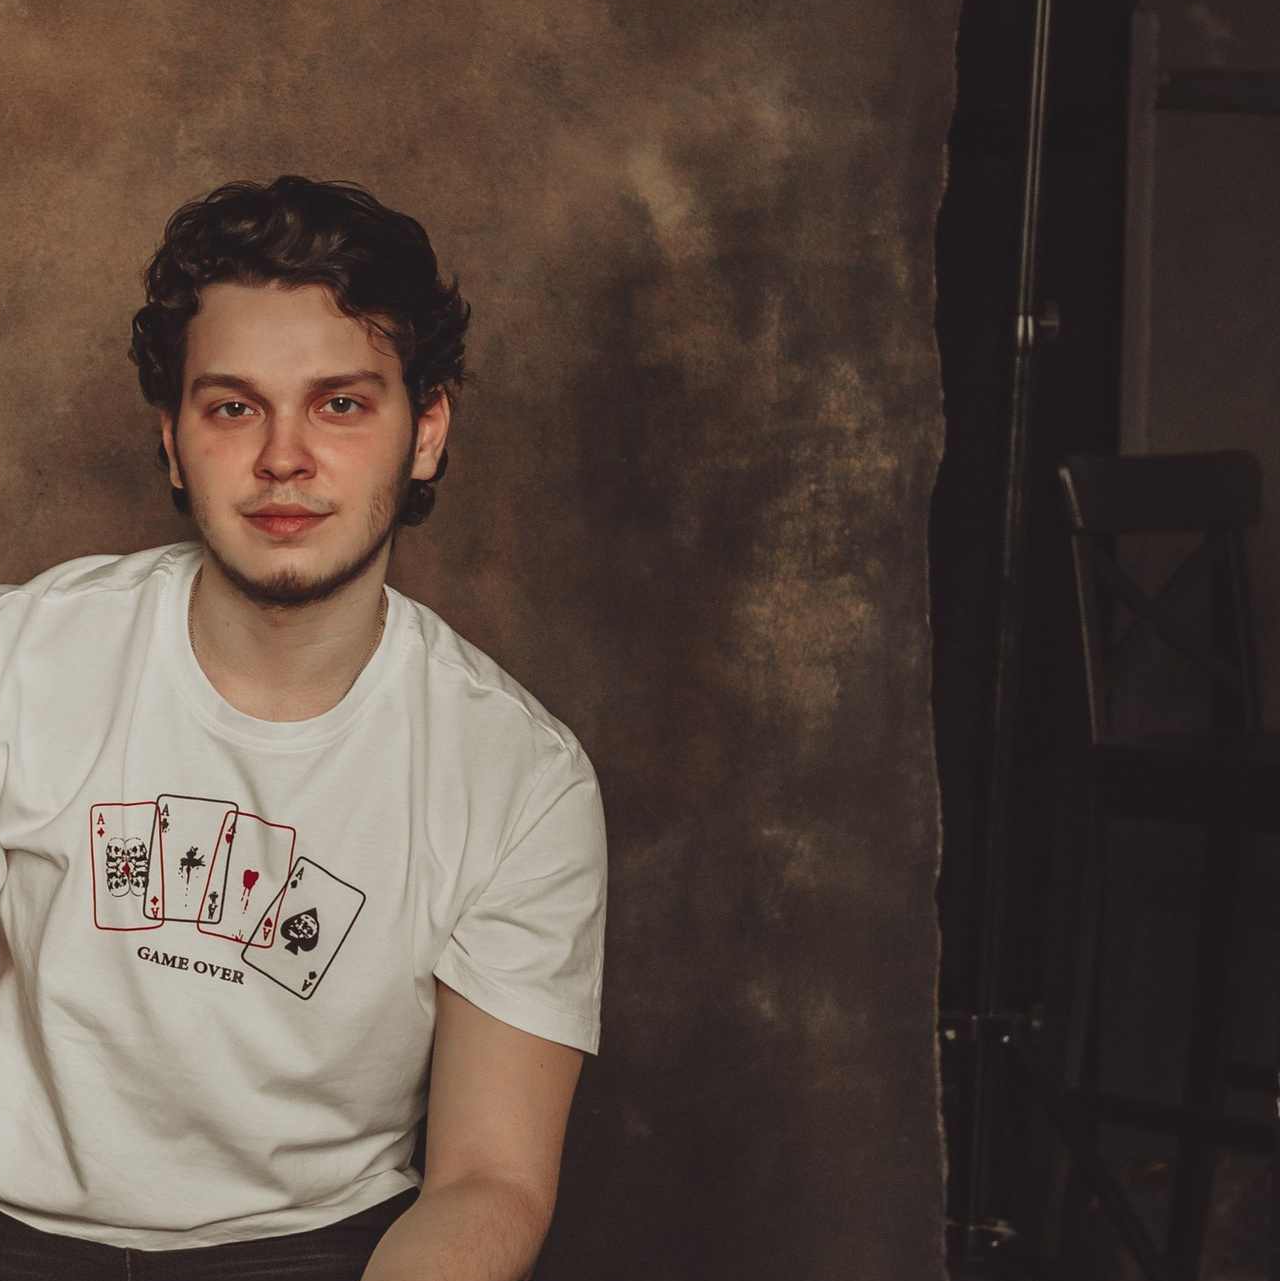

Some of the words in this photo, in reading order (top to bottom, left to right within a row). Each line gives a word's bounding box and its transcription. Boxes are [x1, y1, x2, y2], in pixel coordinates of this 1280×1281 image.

[161, 803, 170, 817] A
[96, 812, 106, 825] A
[227, 820, 237, 834] A
[294, 866, 305, 881] A
[150, 906, 160, 919] A
[207, 903, 219, 920] A
[262, 926, 272, 941] A
[136, 946, 190, 971] GAME
[193, 960, 245, 985] OVER
[301, 978, 313, 992] A
